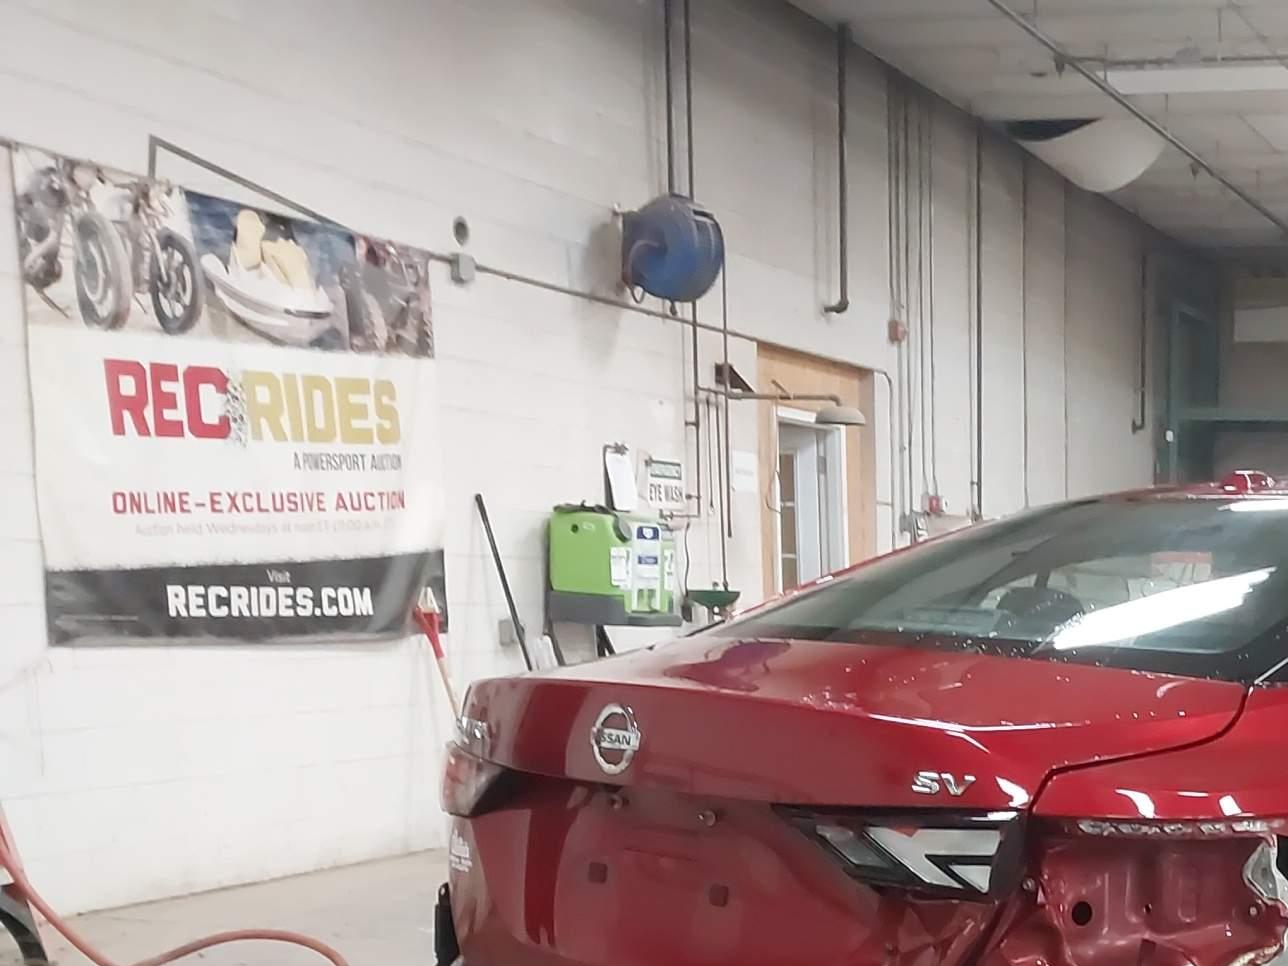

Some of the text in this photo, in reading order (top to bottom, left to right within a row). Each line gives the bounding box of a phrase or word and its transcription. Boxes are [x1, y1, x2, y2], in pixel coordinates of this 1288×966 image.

[293, 452, 402, 472] A POWERSPORT AUCTION
[112, 490, 405, 515] ONLINE-EXCLUSIVE AUCTION
[649, 483, 663, 502] EYE
[267, 569, 291, 584] Visit
[166, 584, 374, 618] RECRIDES.COM
[911, 771, 977, 797] SV
